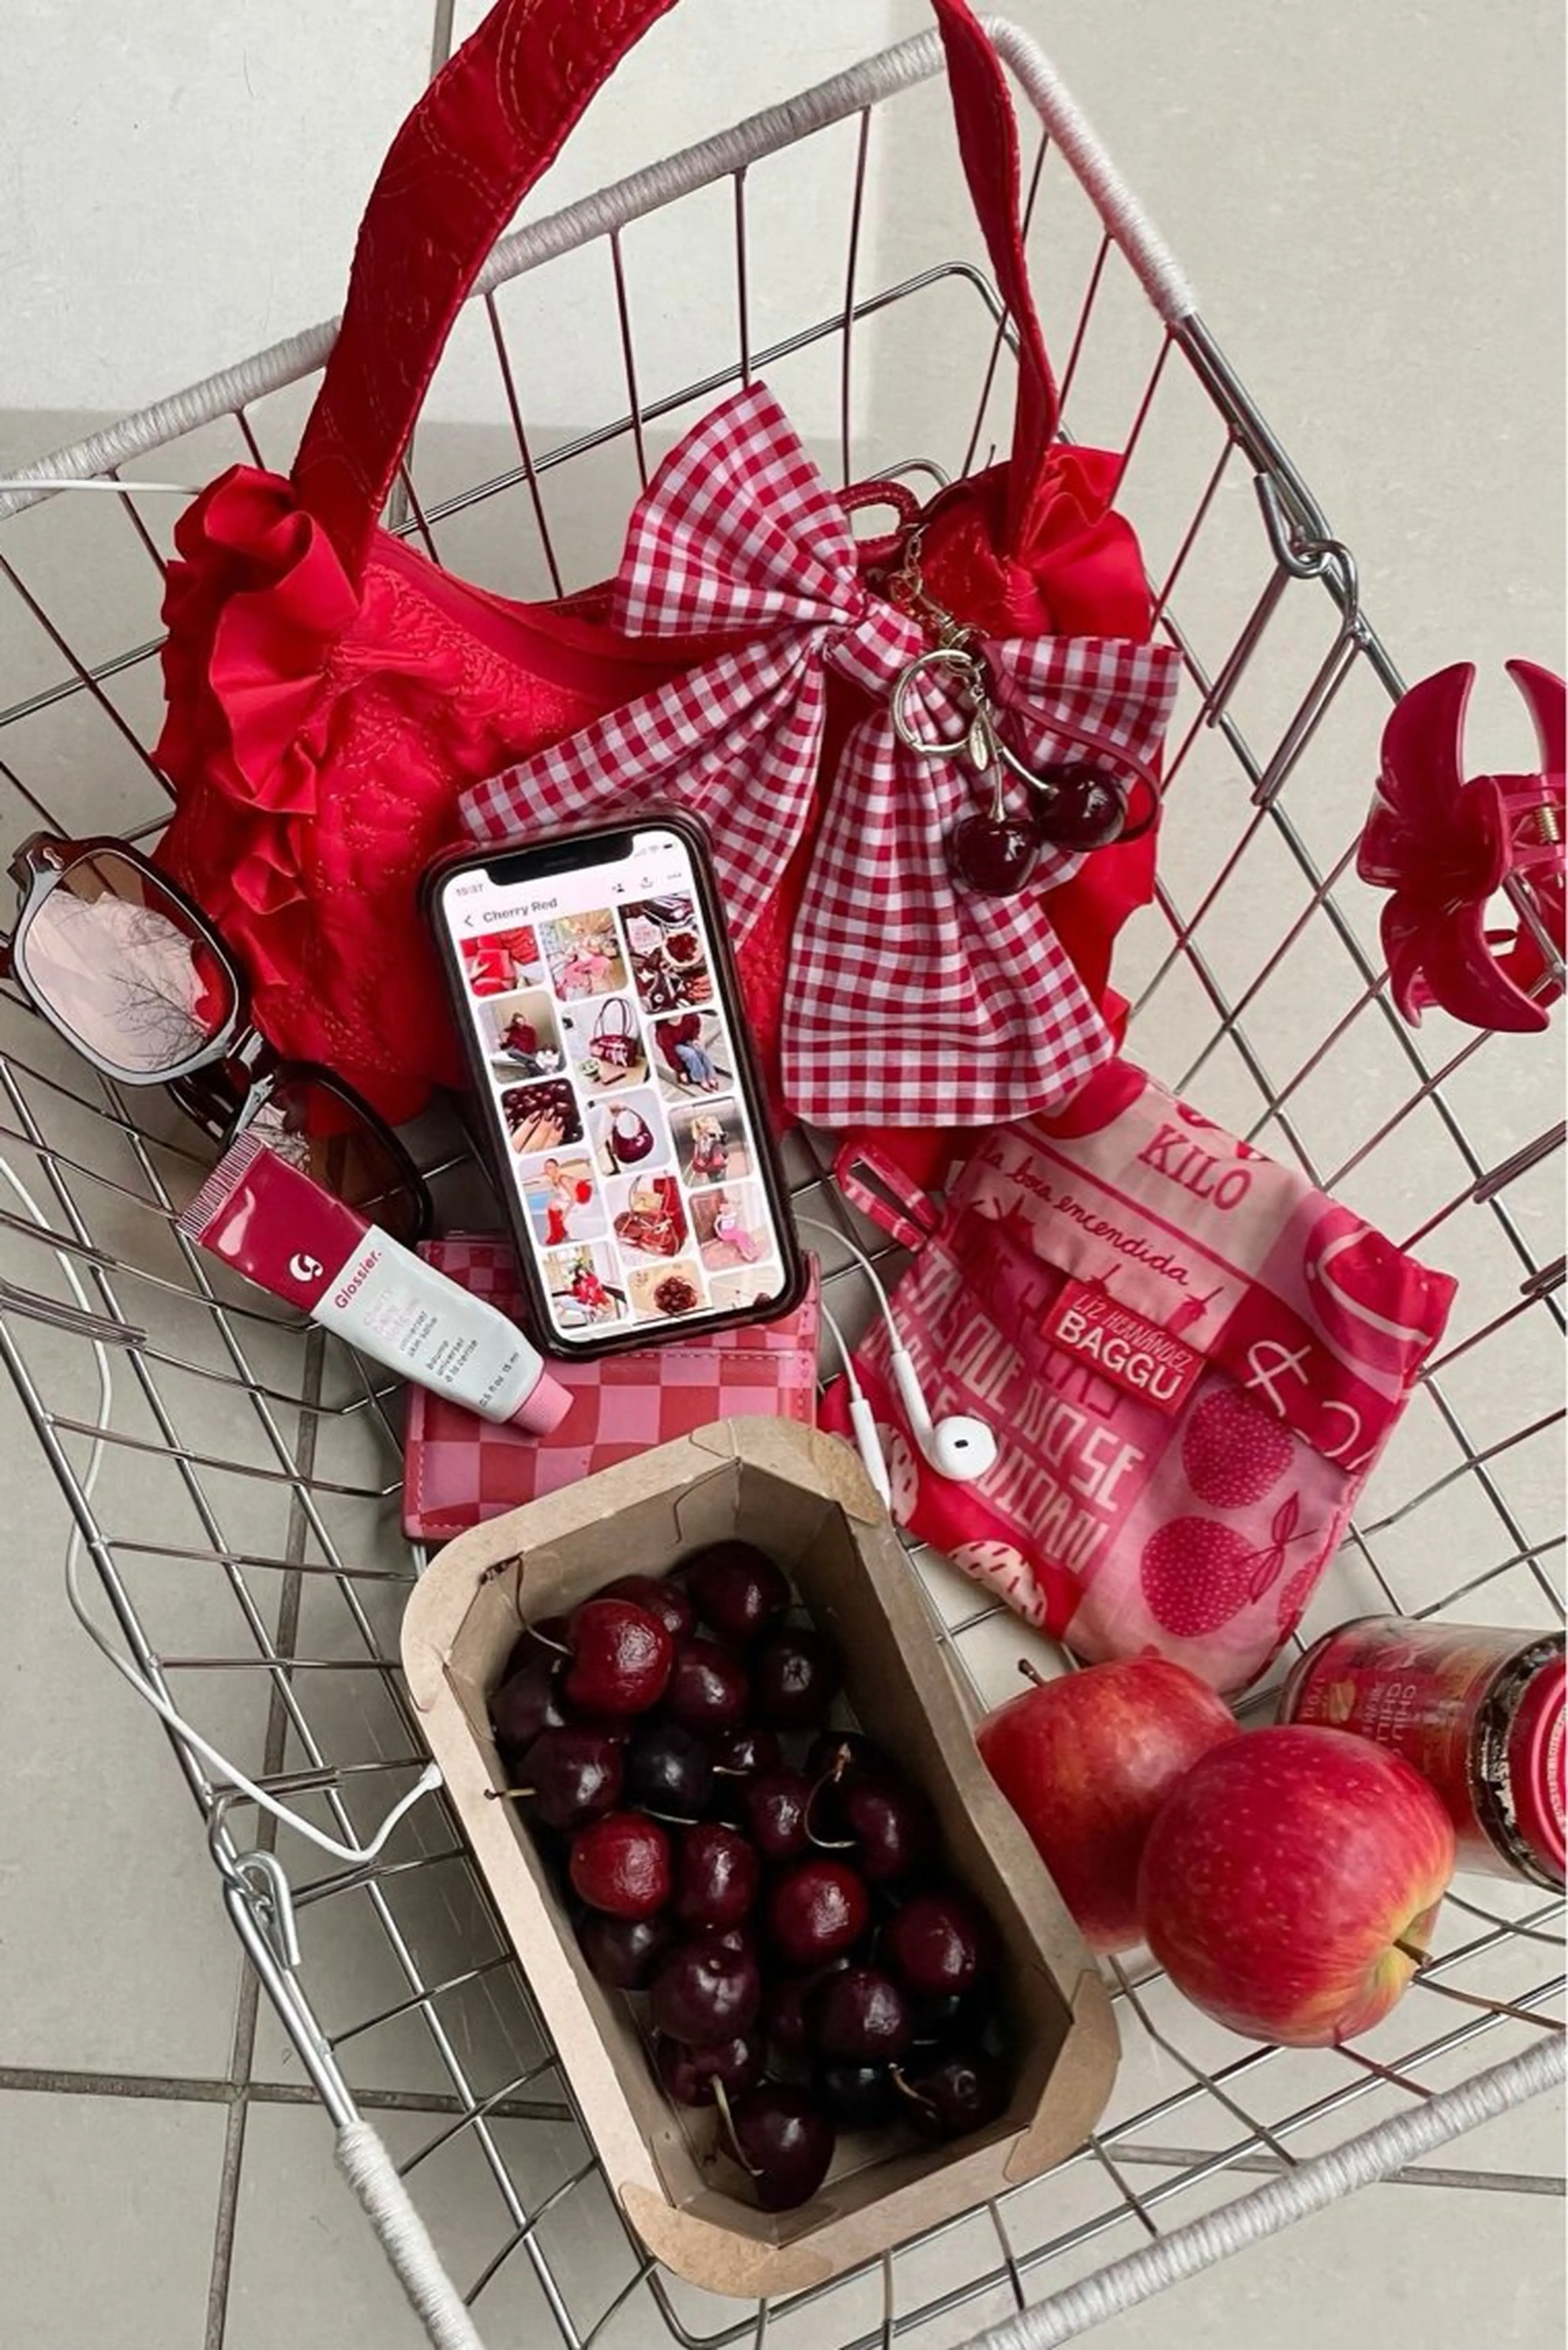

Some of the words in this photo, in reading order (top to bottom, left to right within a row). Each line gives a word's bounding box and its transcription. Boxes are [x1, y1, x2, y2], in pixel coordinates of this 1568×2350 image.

[483, 905, 528, 923] Cherry
[532, 898, 558, 912] Red
[1138, 1123, 1252, 1211] KILO
[1054, 1195, 1188, 1286] encendida
[1056, 1308, 1183, 1401] BAGGU
[1013, 1379, 1088, 1468] NO
[1069, 1426, 1146, 1512] SE
